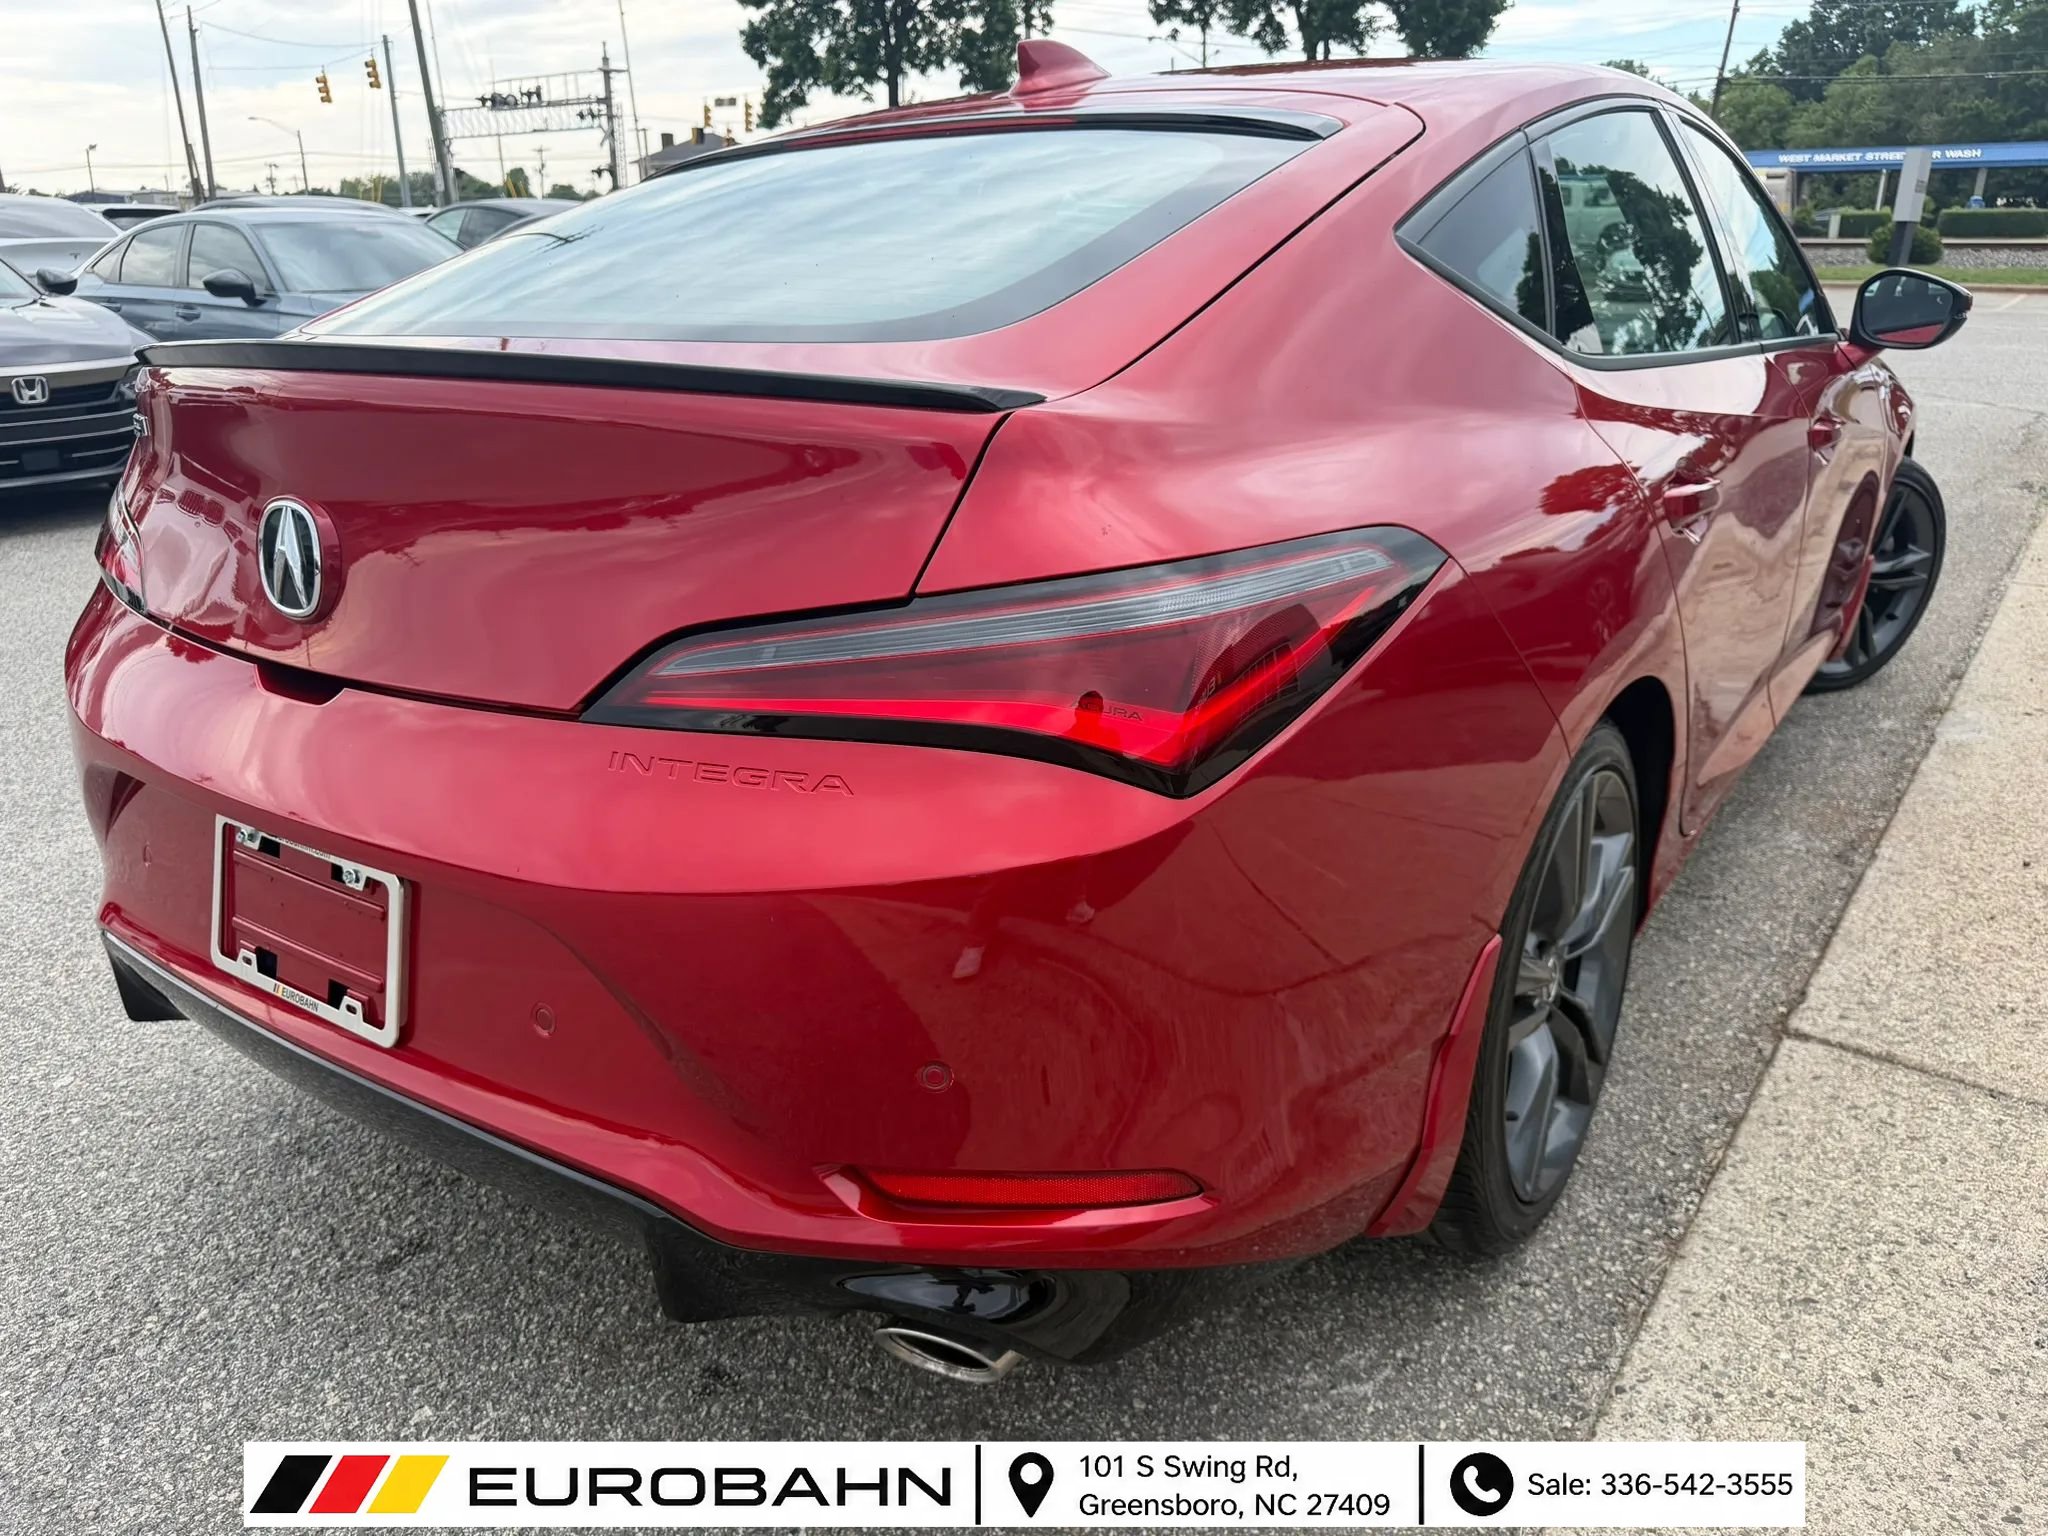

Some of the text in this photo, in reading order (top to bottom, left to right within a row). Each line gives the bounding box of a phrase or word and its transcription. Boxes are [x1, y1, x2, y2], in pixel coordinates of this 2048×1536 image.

[1778, 153, 1812, 163] WEST
[1813, 152, 1863, 162] MARKET
[1864, 151, 1906, 161] STREE
[1945, 149, 1981, 159] WASH
[608, 751, 854, 797] INTEGRA
[281, 986, 319, 1012] EUROBAHN
